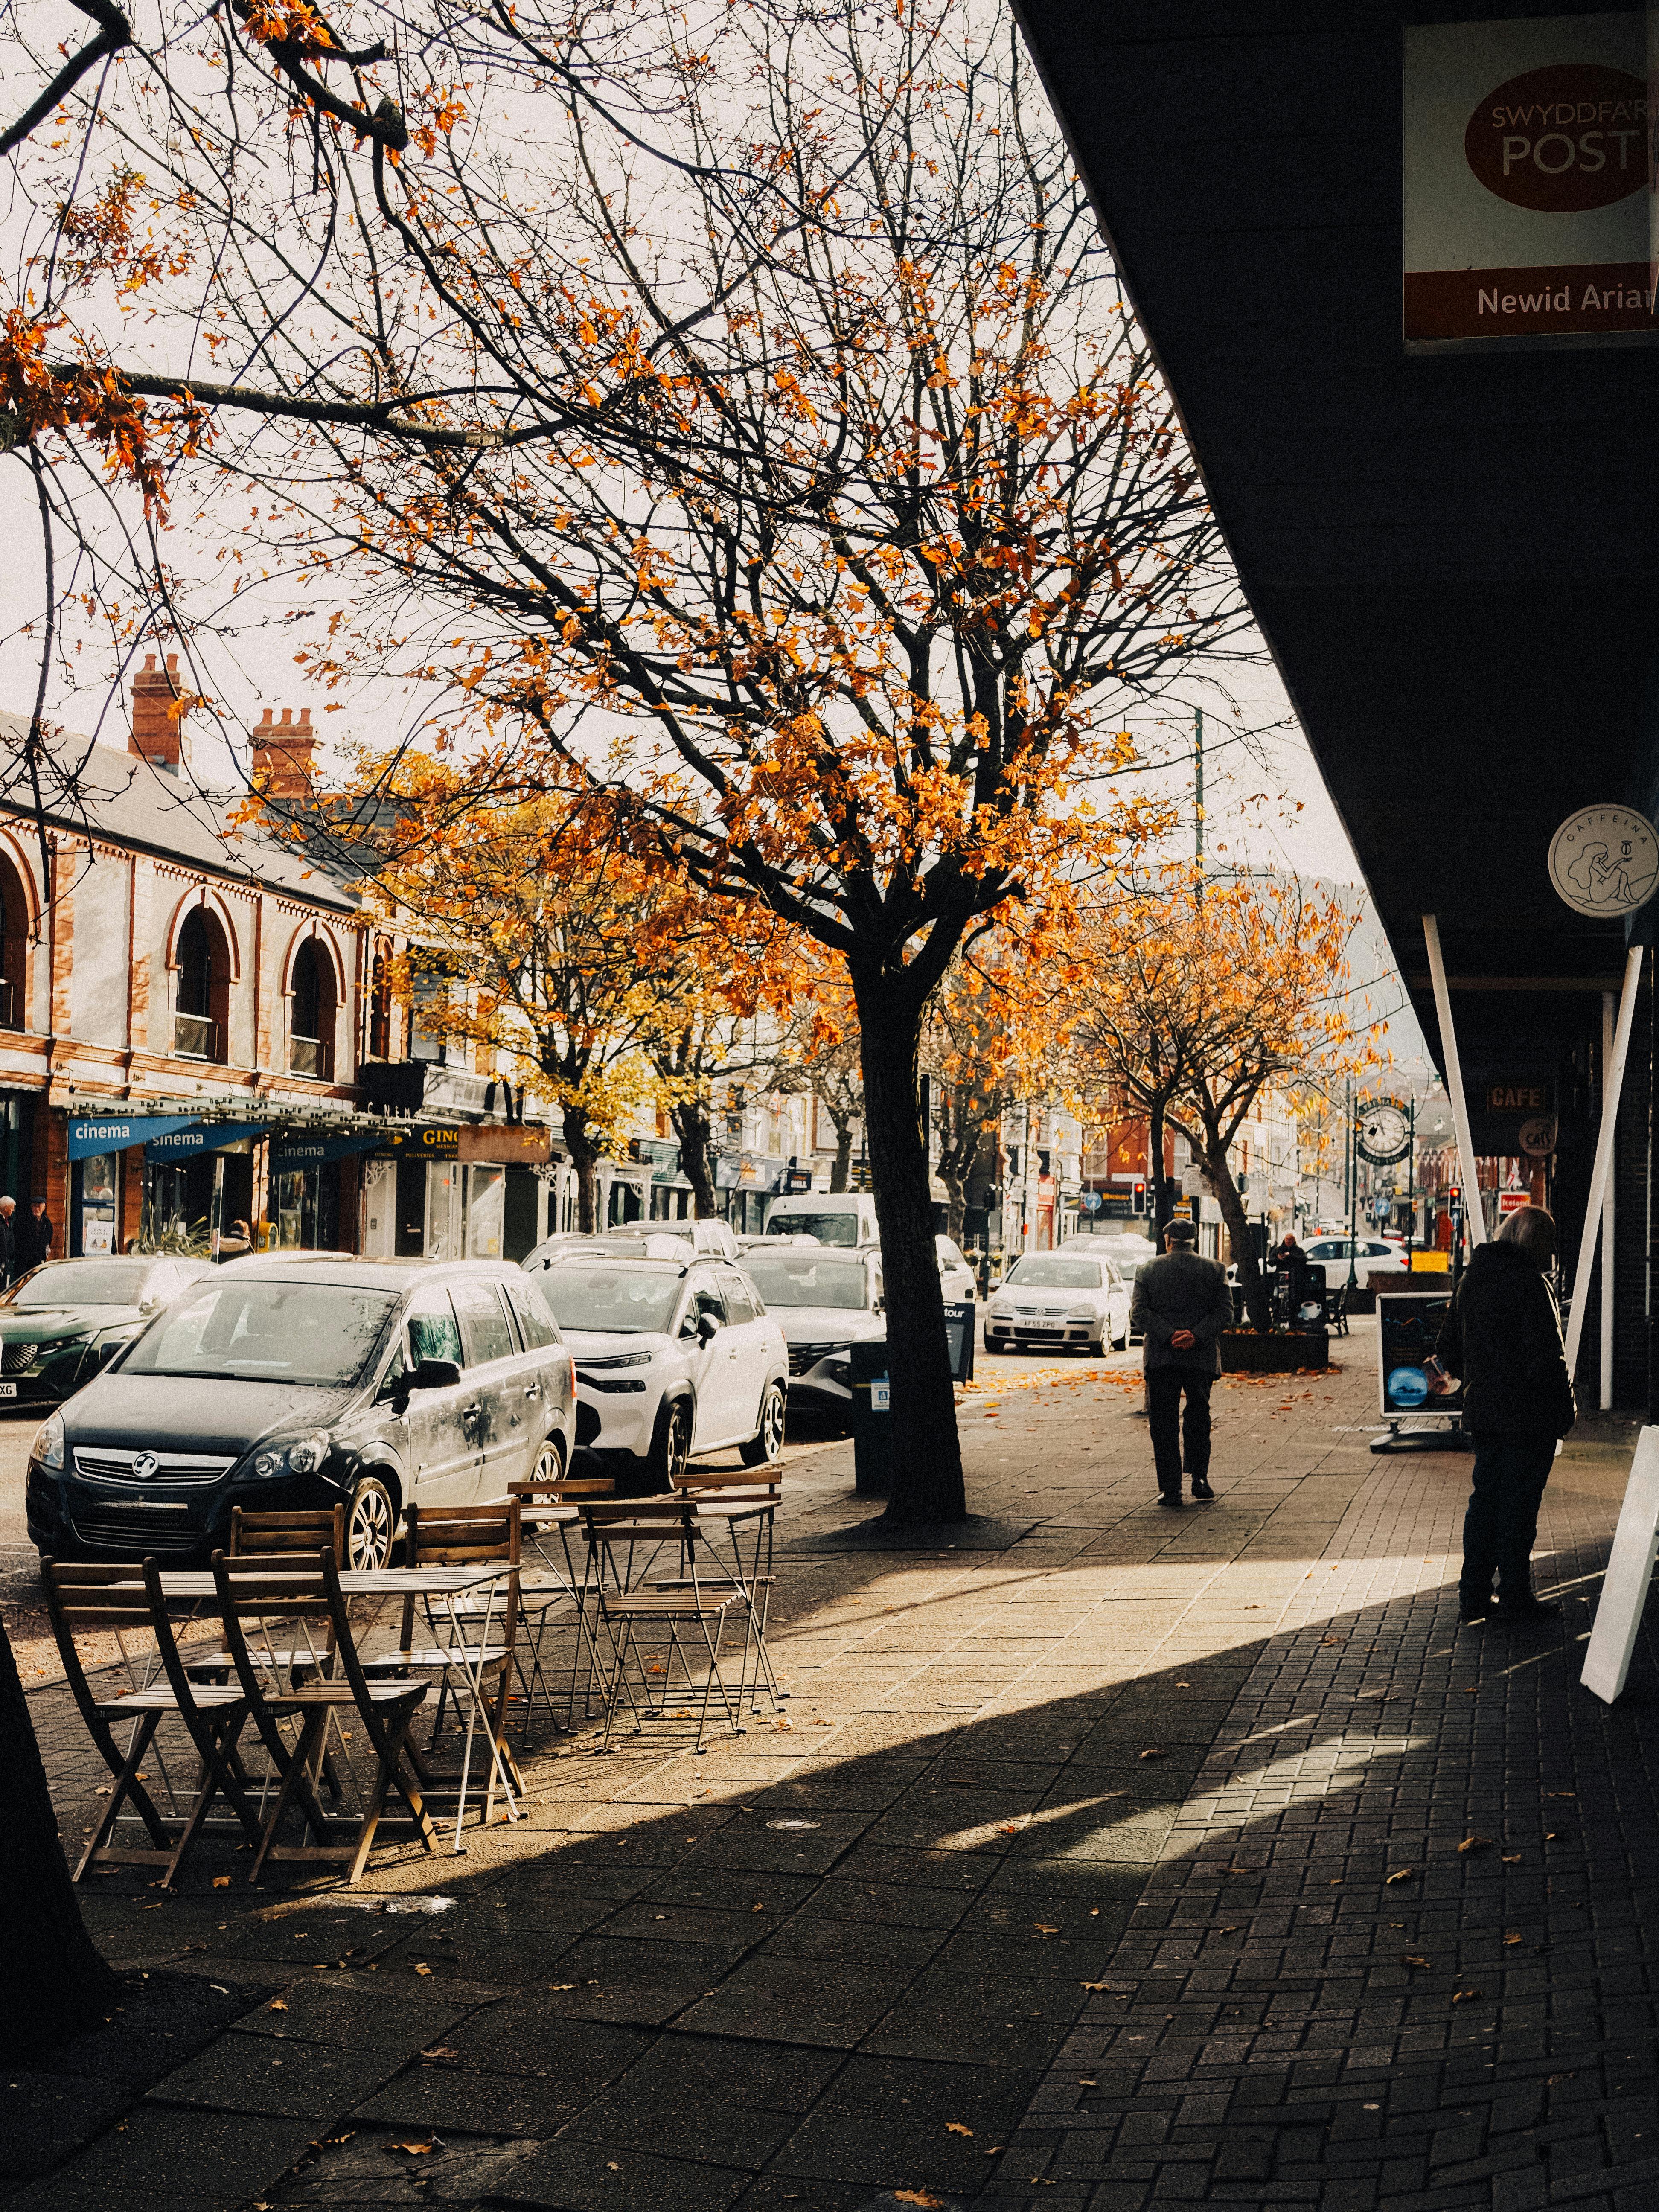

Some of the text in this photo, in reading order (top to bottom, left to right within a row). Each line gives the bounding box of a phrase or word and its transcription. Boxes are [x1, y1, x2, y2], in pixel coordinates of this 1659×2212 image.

[1491, 98, 1648, 129] SWYDDFA'R
[1502, 129, 1640, 176] POST
[1478, 285, 1572, 315] Newid
[1566, 814, 1648, 844] CAFFEINA
[1492, 1087, 1540, 1107] CAFE
[76, 1123, 131, 1140] cinema
[277, 1144, 325, 1157] cinema
[944, 1308, 965, 1318] tour
